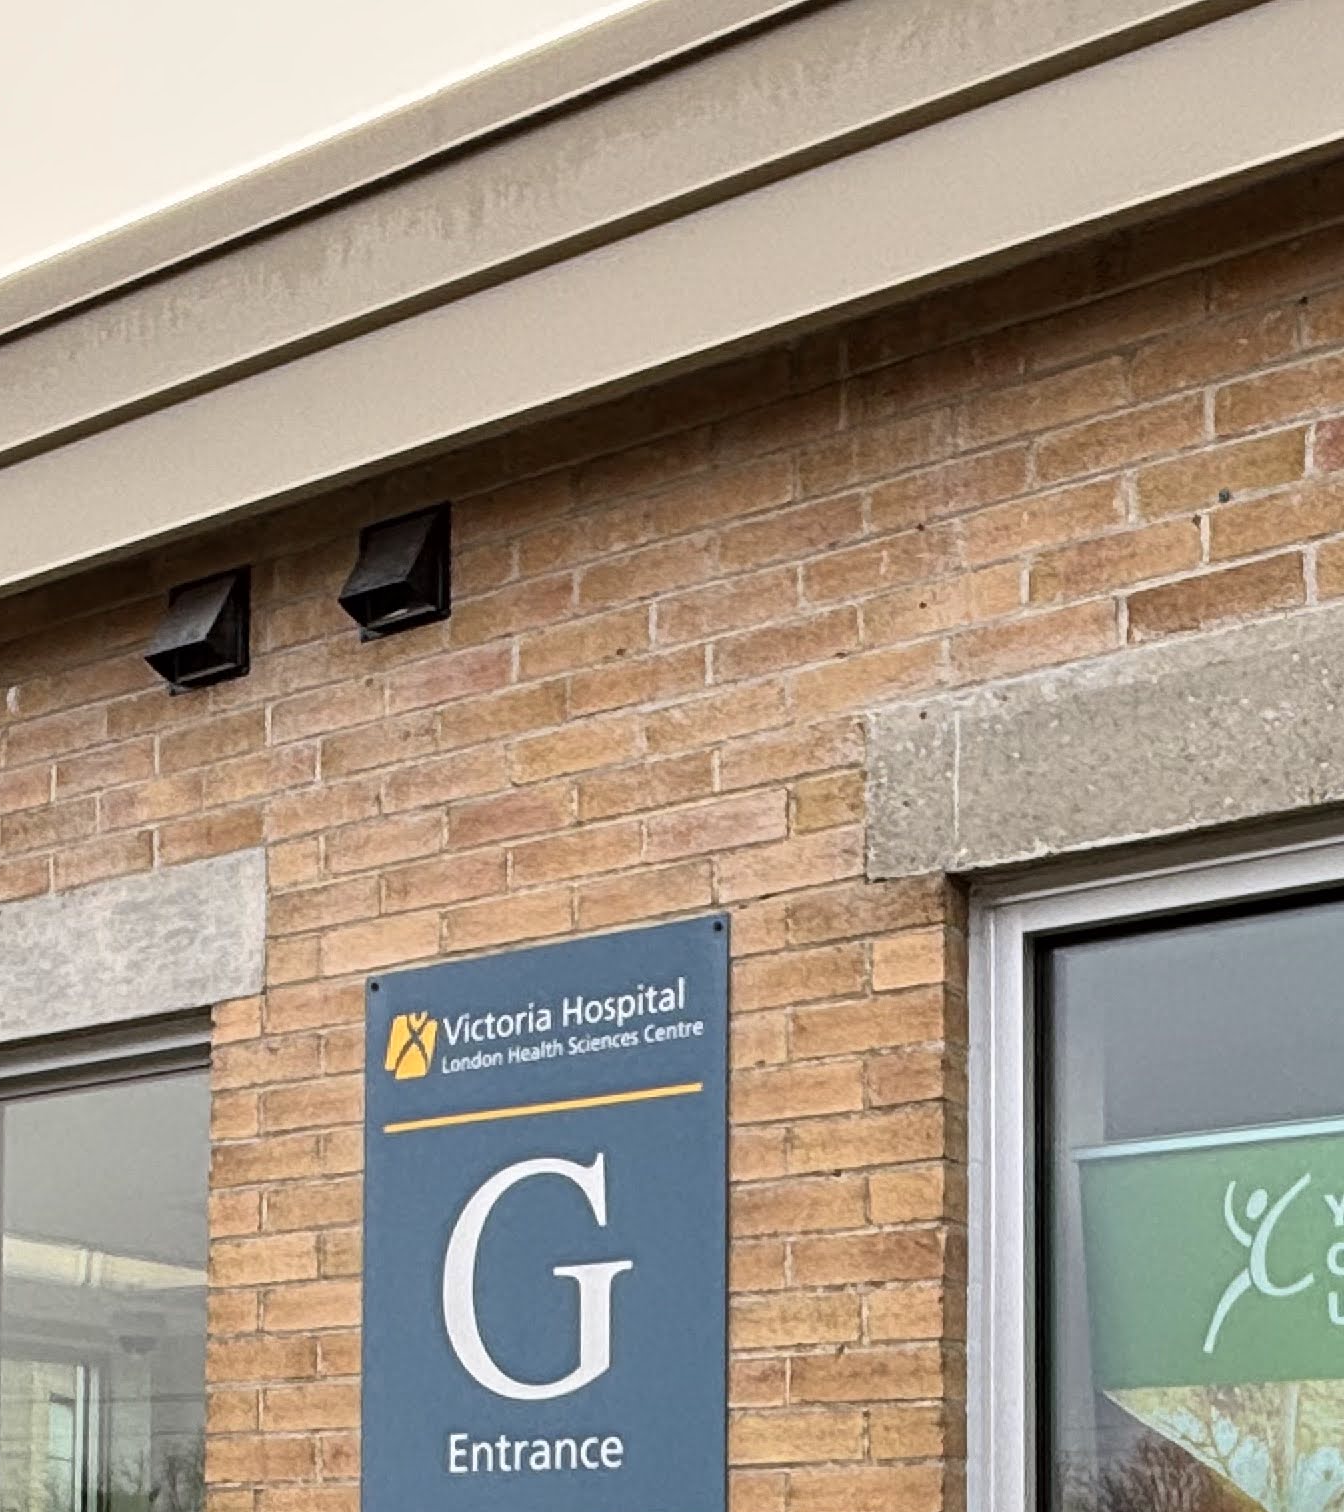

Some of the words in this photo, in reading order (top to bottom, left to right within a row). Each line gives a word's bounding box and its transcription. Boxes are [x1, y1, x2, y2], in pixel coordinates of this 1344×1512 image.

[443, 1003, 552, 1046] Victoria
[562, 976, 686, 1028] Hospital
[441, 1051, 503, 1074] London
[508, 1039, 563, 1064] Health
[568, 1030, 639, 1056] Sciences
[644, 1020, 704, 1043] Centre
[442, 1152, 633, 1401] G
[448, 1432, 625, 1474] Entrance
